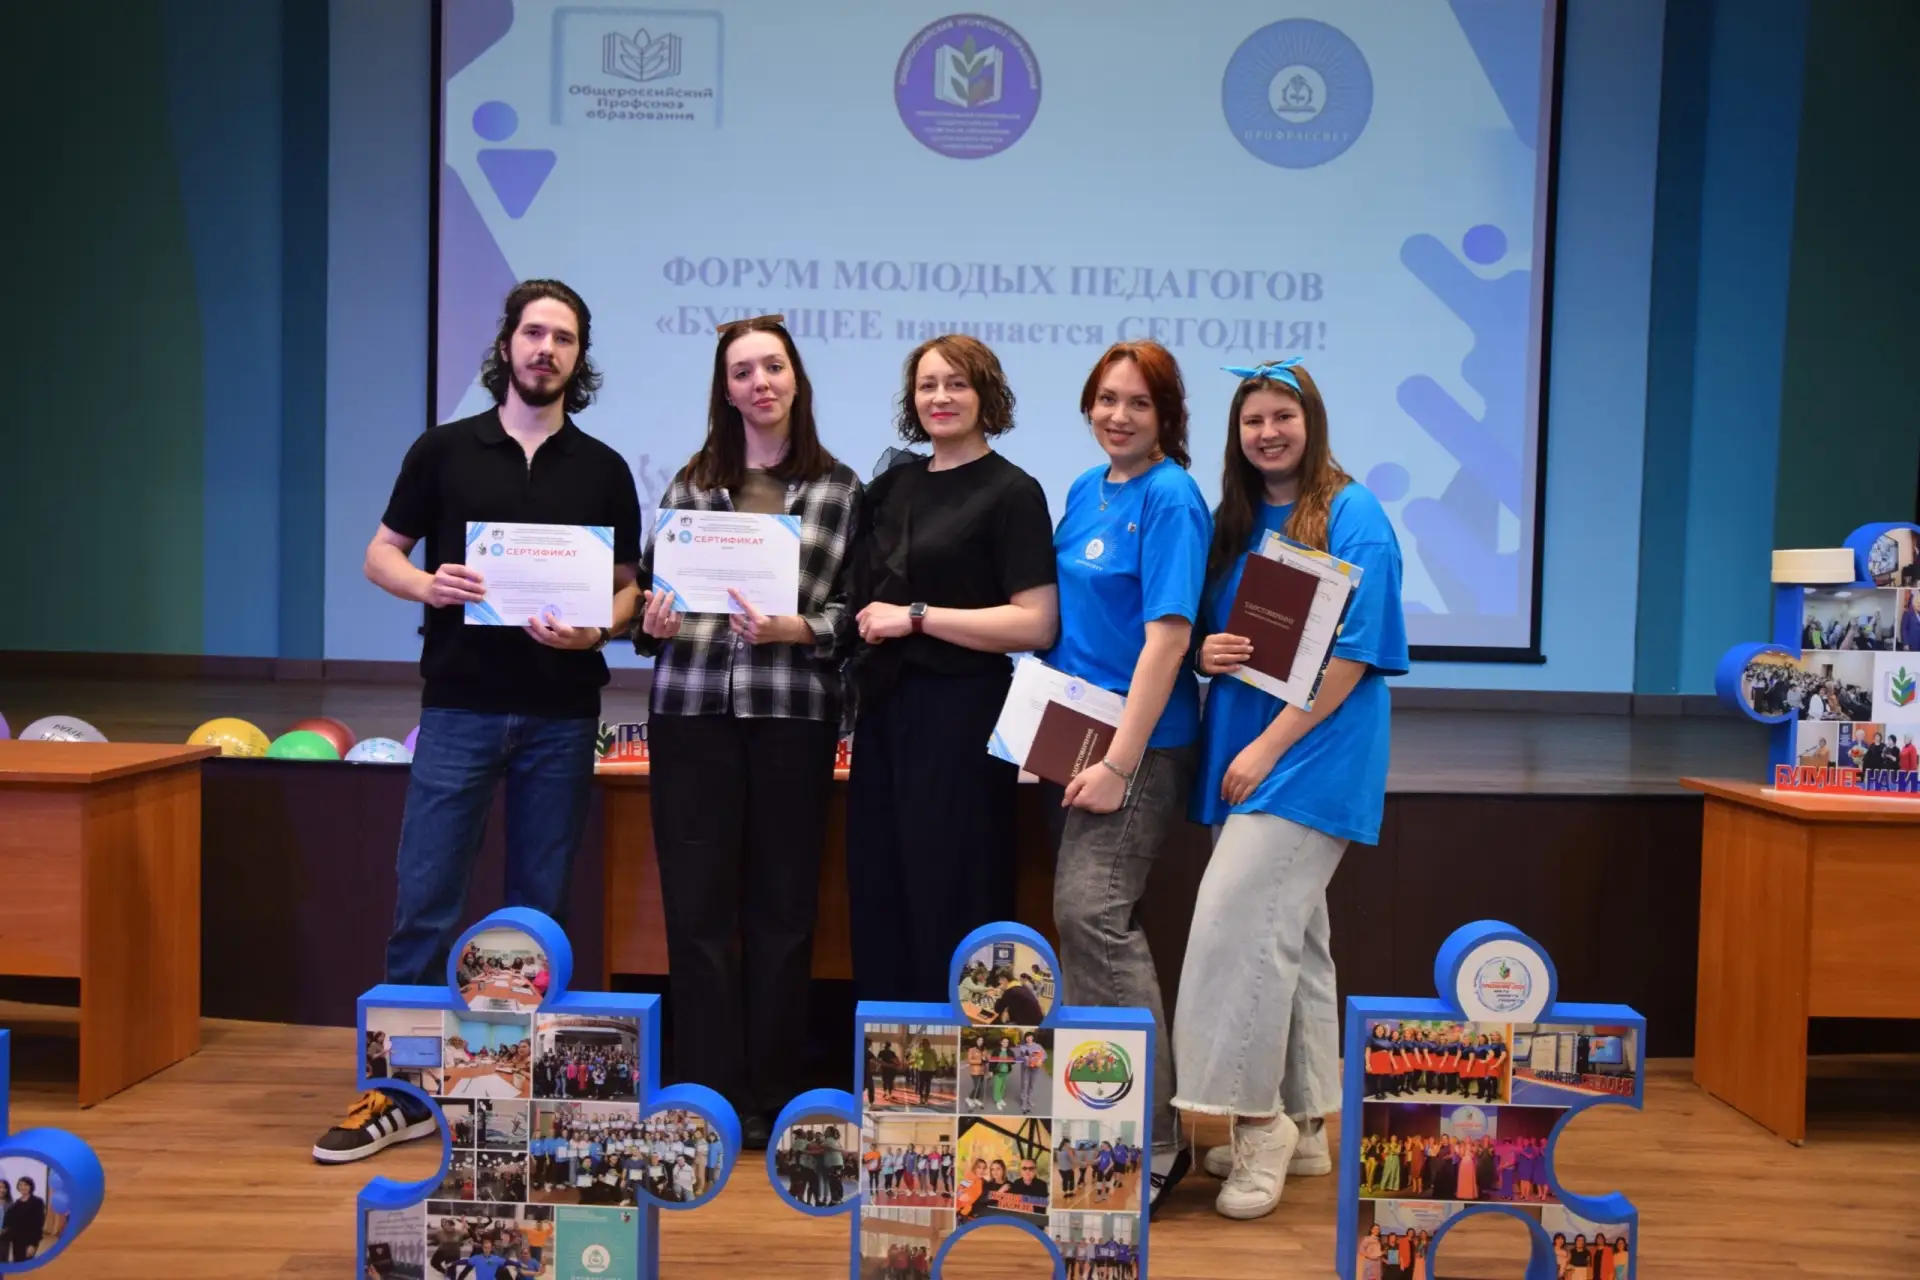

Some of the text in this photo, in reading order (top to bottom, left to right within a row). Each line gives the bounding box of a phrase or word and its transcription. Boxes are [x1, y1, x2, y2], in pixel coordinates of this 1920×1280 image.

[568, 84, 714, 99] Общероссийский
[596, 98, 685, 110] Профсоюз
[585, 109, 696, 121] образования
[661, 254, 1325, 303] ФОРУМ МОЛОДЫХ ПЕДАГОГОВ
[1116, 315, 1327, 355] СЕГОДНЯ!
[693, 535, 765, 546] СЕРТИФИКАТ
[506, 547, 578, 558] СЕРТИФИКАТ
[1775, 764, 1865, 791] БУДУЩЕЕ
